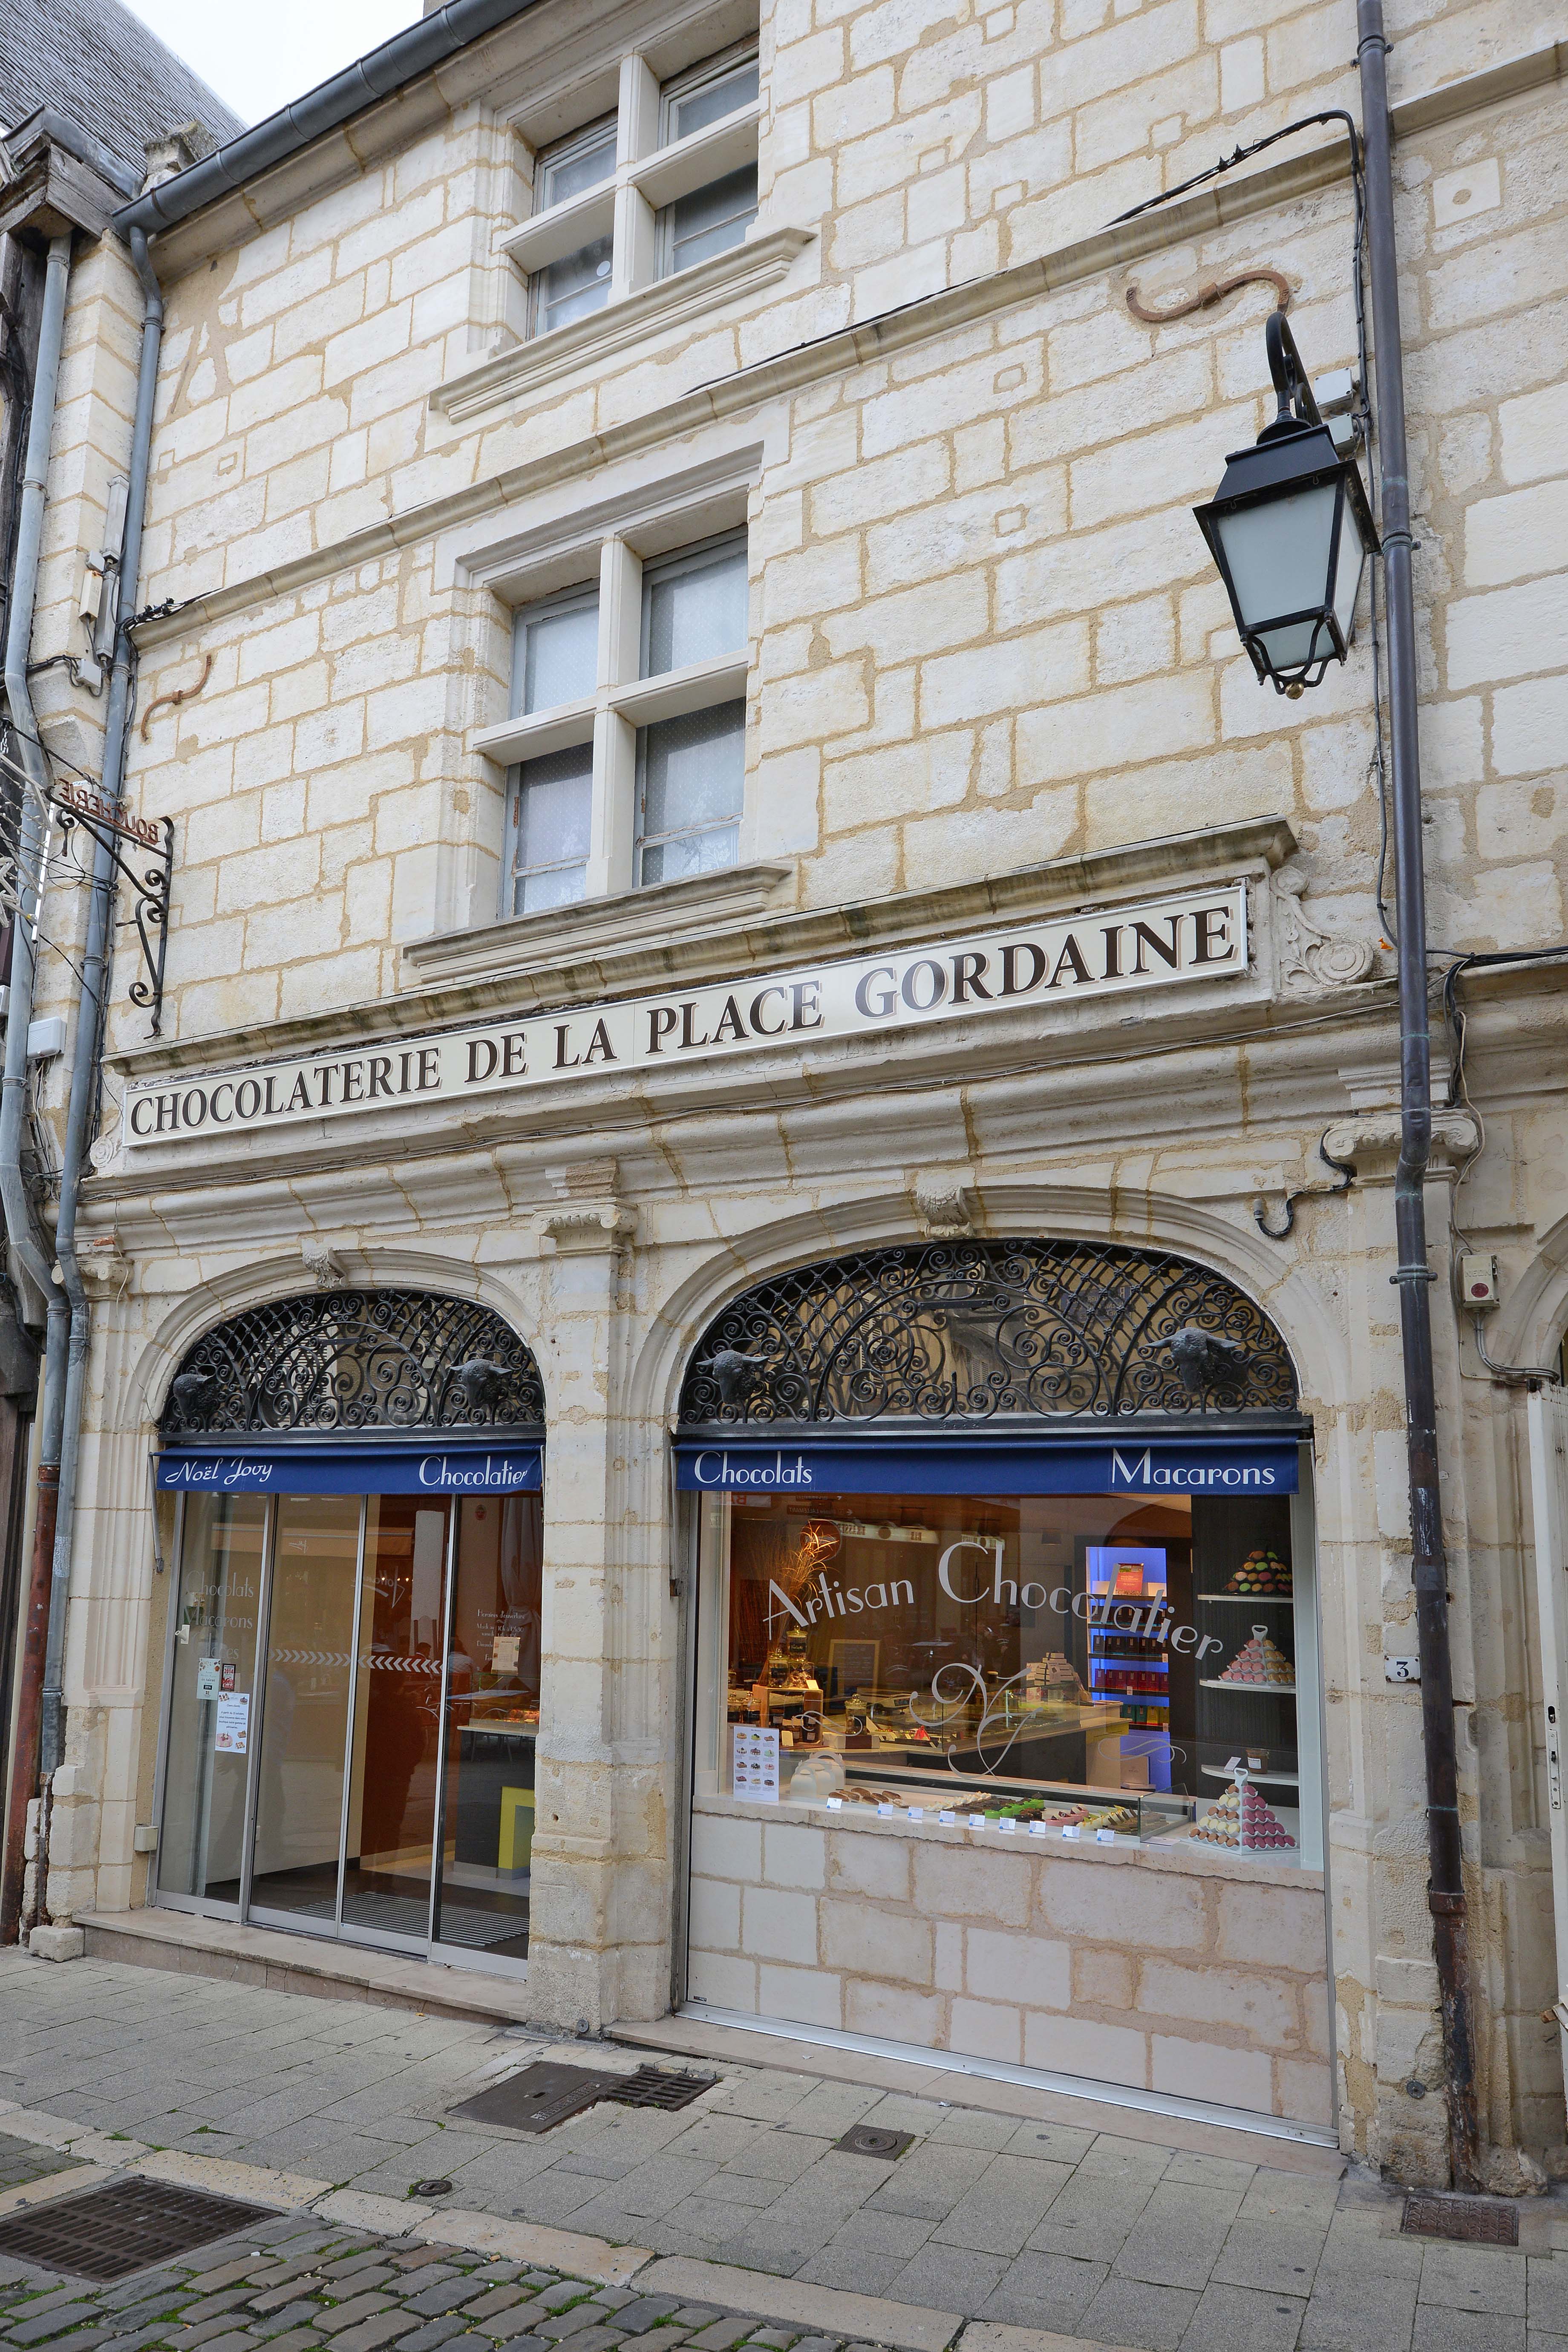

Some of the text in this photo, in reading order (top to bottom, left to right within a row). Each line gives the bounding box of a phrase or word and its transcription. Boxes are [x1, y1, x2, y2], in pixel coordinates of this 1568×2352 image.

[130, 906, 1235, 1137] CHOCOLATERIE DE LA PLACE GORDAINE
[165, 1457, 222, 1483] Noël
[420, 1455, 528, 1486] Chocolatier
[695, 1450, 813, 1485] Chocolats
[1111, 1447, 1276, 1486] Macarons
[186, 1570, 254, 1597] Chocolats
[183, 1599, 253, 1629] Macarons
[477, 1609, 498, 1618] Horaires
[763, 1541, 1223, 1660] Artisan Chocolatier
[1396, 1661, 1409, 1678] 3
